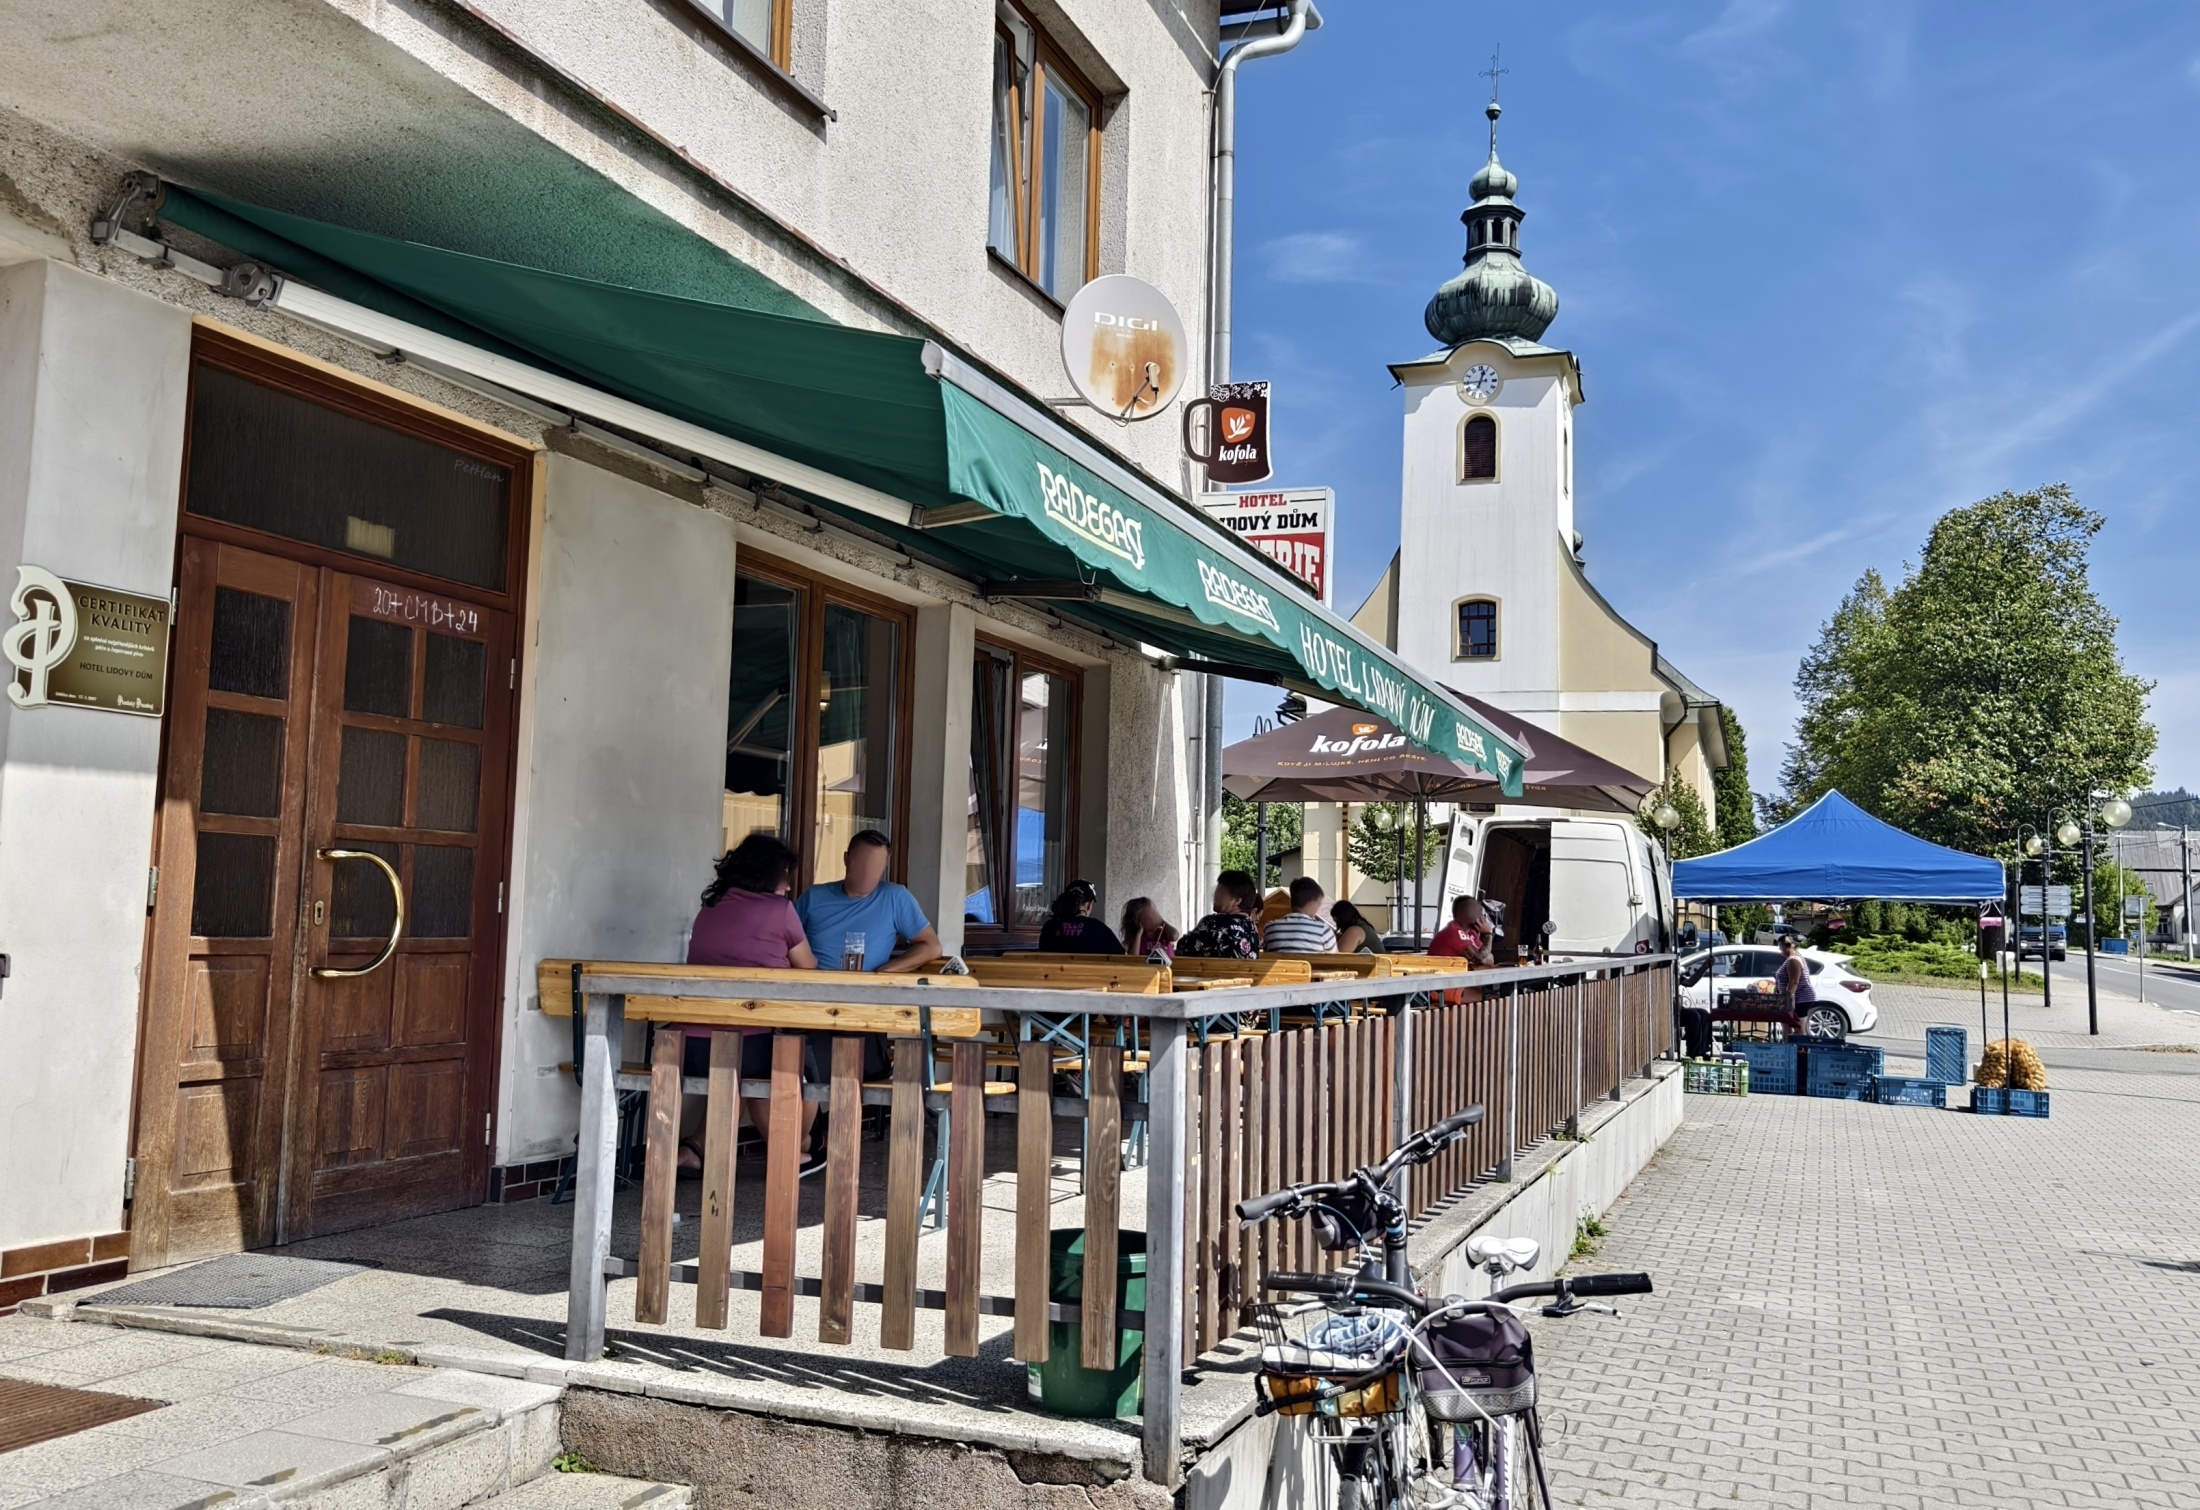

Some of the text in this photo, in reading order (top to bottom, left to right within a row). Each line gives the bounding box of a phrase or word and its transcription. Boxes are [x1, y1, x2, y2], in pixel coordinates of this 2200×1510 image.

[1094, 311, 1158, 331] DIGI
[1218, 444, 1257, 465] kofola
[1239, 493, 1287, 508] HOTEL
[1219, 508, 1318, 532] DOVÝ DŮM
[79, 595, 165, 622] CERTIFIKÁT
[91, 613, 152, 635] KVALITY
[80, 662, 153, 680] HOTEL LIDOVÝ DŮM
[1300, 620, 1361, 694] HOTEL
[1361, 660, 1406, 726] LIDOVÝ
[1309, 733, 1406, 757] kofola
